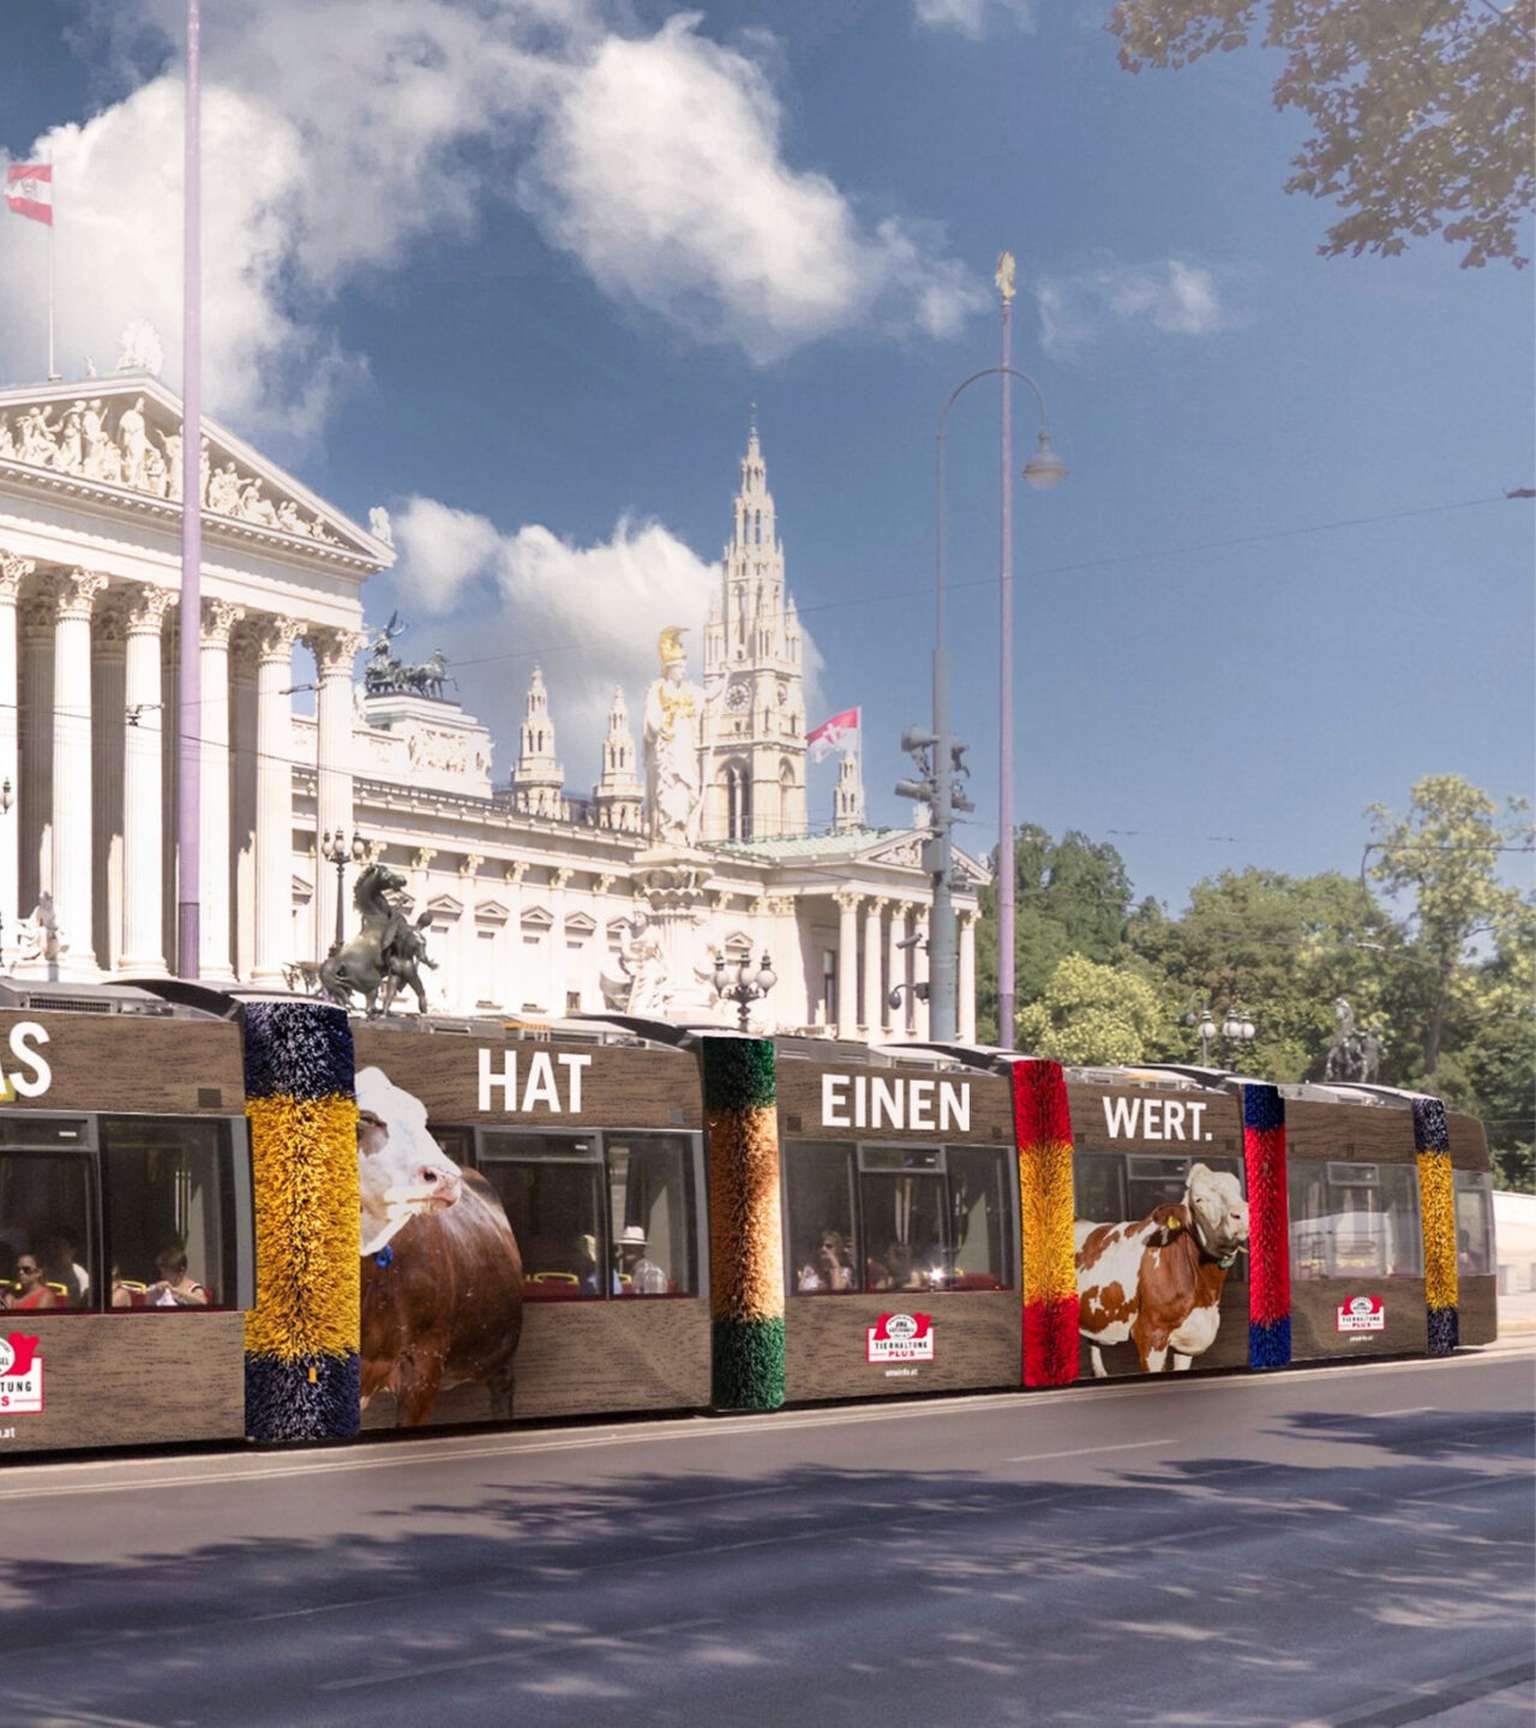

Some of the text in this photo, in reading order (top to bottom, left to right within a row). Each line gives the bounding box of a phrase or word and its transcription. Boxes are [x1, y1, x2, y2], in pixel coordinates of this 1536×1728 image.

[478, 1048, 592, 1113] HAT
[822, 1073, 970, 1132] EINEN
[1102, 1096, 1213, 1141] WERT.
